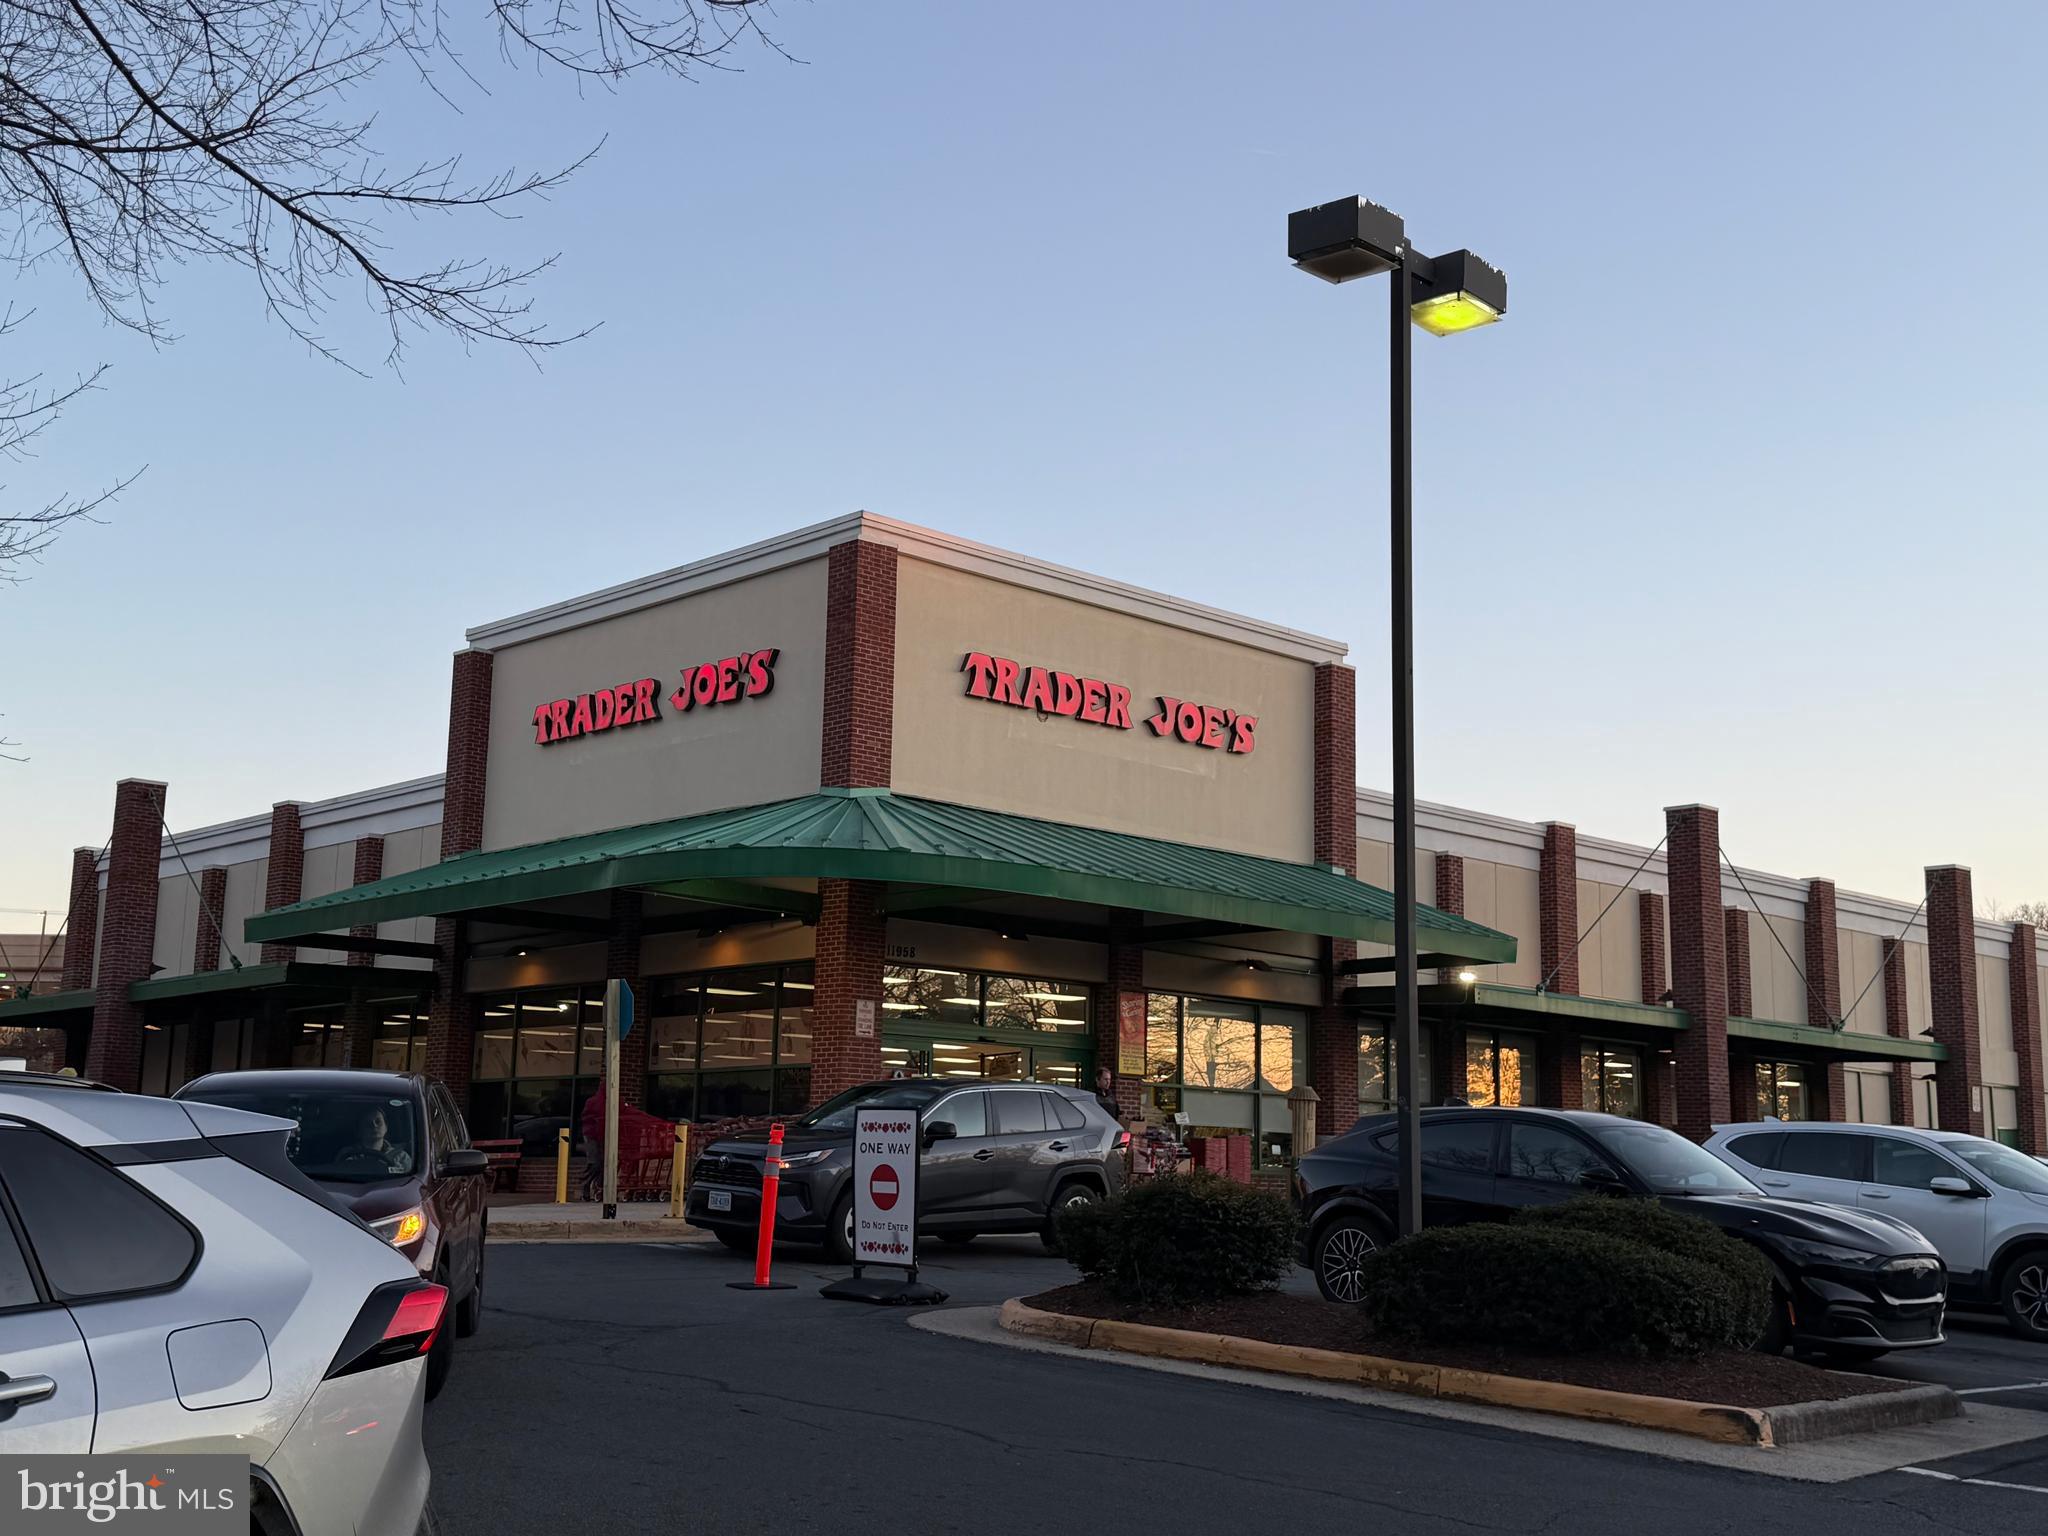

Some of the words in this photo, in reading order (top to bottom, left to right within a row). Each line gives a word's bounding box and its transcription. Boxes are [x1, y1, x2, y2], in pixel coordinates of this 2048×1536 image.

[532, 678, 663, 745] TRADER
[668, 648, 780, 713] JOE'S
[960, 652, 1134, 730] TRADER
[1143, 696, 1259, 753] JOE'S
[887, 944, 916, 959] 11958
[859, 1142, 884, 1154] ONE
[888, 1143, 911, 1155] WAY
